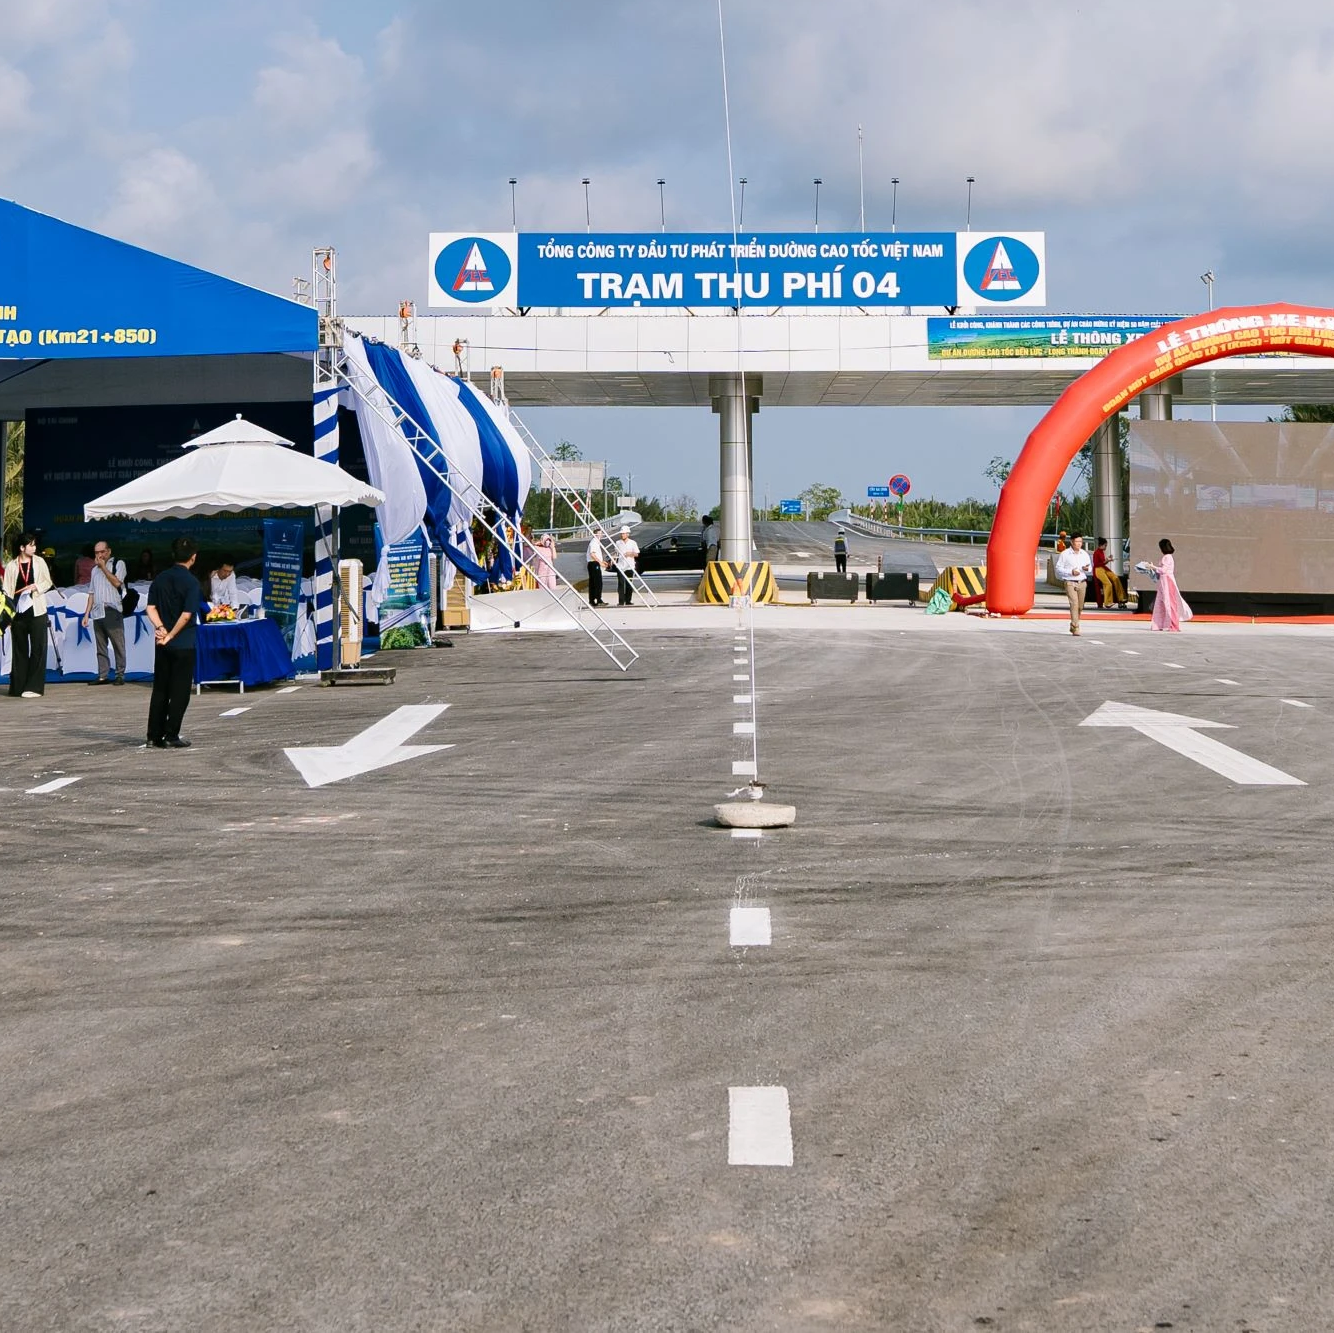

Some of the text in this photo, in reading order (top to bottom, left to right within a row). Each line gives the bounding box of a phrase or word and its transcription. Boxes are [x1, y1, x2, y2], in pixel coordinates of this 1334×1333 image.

[537, 237, 943, 261] TỔNG CÔNG TY ĐẦU TƯ PHÁT TRIỂN ĐƯỜNG CAO TỐC VIỆT NAM
[577, 264, 901, 306] TRẠM THU PHÍ 04
[39, 329, 156, 345] (Km21+850)
[1051, 329, 1121, 345] LỄ THÔNG
[1157, 330, 1185, 353] LỄ
[1185, 315, 1264, 341] THÔNG
[1269, 314, 1300, 326] XE
